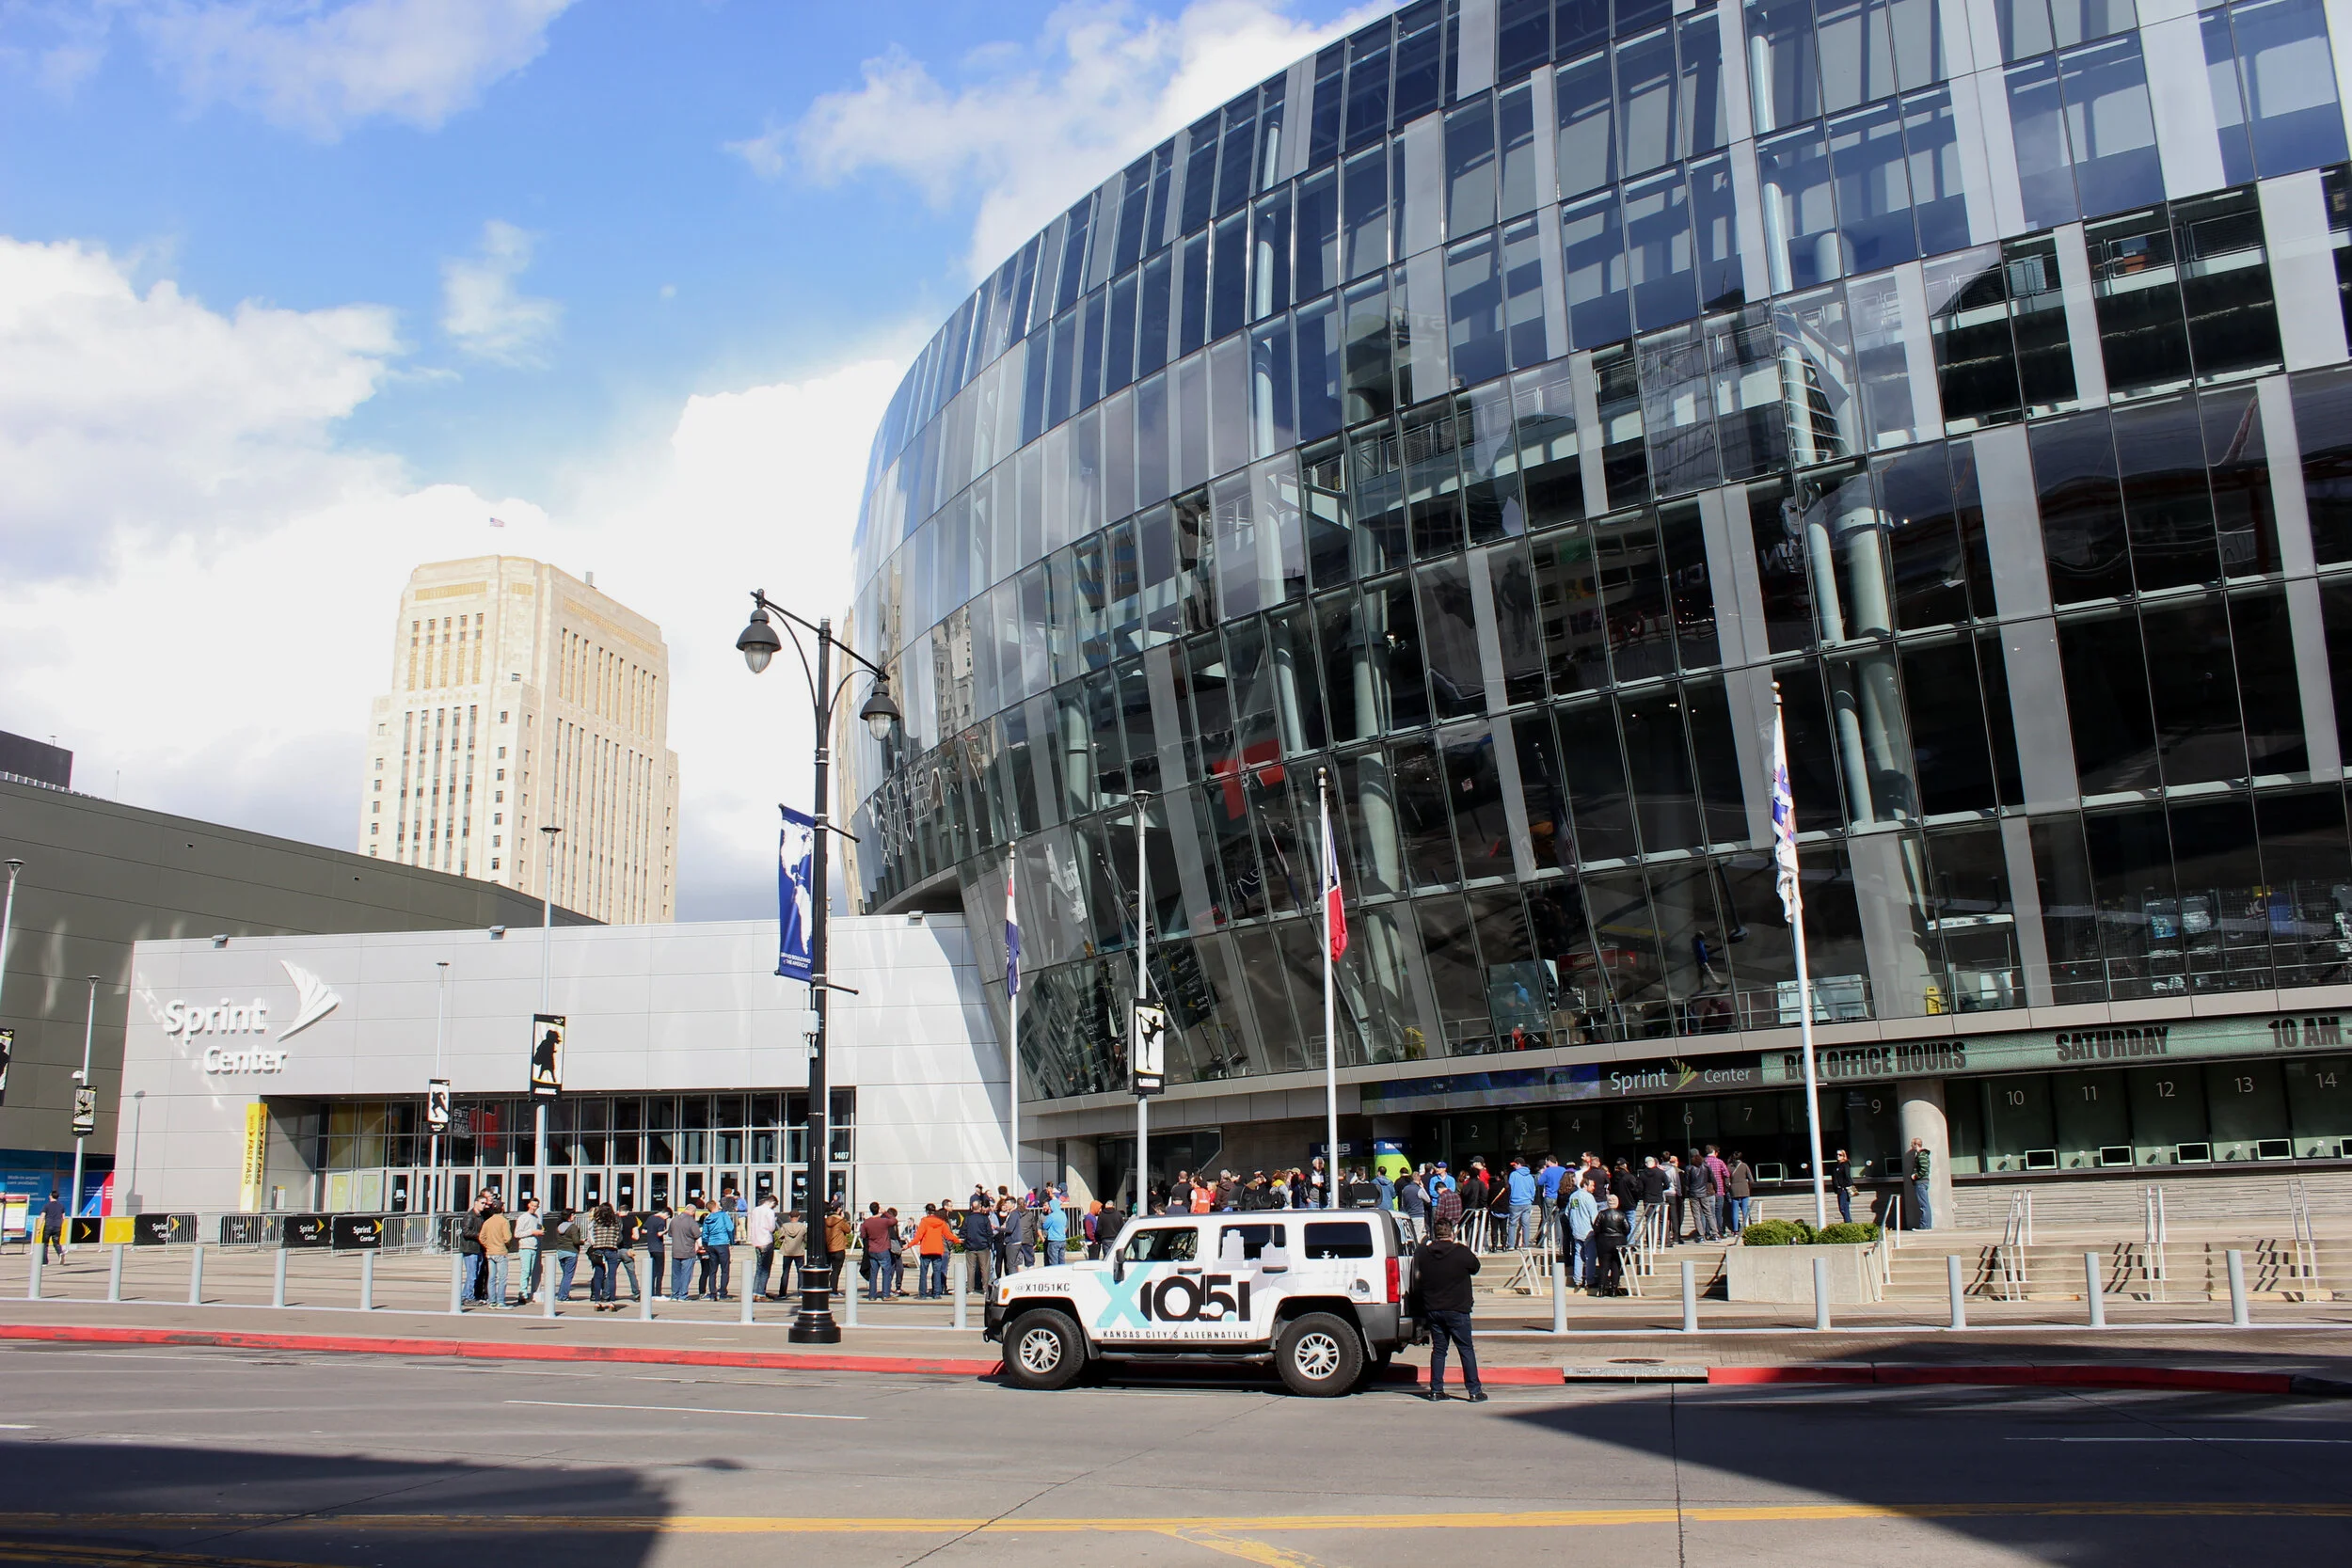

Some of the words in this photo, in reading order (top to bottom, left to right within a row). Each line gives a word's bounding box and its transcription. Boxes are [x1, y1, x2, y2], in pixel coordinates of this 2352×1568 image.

[163, 997, 269, 1044] Sprint
[1826, 1046, 1893, 1077] OFFICE
[1895, 1041, 1966, 1073] HOURS
[2056, 1025, 2169, 1061] SATURDAY
[2267, 1018, 2298, 1048] 10
[2303, 1016, 2342, 1046] AM
[202, 1045, 289, 1075] Center
[1610, 1067, 1668, 1095] Sprint
[1704, 1068, 1751, 1084] Center
[2235, 1077, 2254, 1093] 13
[2315, 1072, 2337, 1088] 14
[2082, 1085, 2097, 1101] 11
[2155, 1082, 2175, 1098] 12
[2007, 1090, 2024, 1105] 10
[1743, 1107, 1753, 1121] 7
[1871, 1100, 1882, 1114] 9
[1571, 1118, 1581, 1132] 4
[1627, 1115, 1635, 1129] 5
[1683, 1112, 1692, 1126] 6
[1470, 1125, 1479, 1138] 2
[1519, 1122, 1528, 1136] 3
[246, 1139, 255, 1161] FAST
[834, 1151, 850, 1160] 1407
[1321, 1143, 1351, 1154] UB
[245, 1163, 253, 1185] PASS
[299, 1225, 314, 1234] Sprint
[353, 1226, 372, 1235] Sprint
[1015, 1282, 1071, 1292] @X1051KC
[1103, 1330, 1140, 1338] KANSAS
[1145, 1330, 1179, 1338] CITY'S
[1184, 1330, 1249, 1338] ALTERNATIVE
